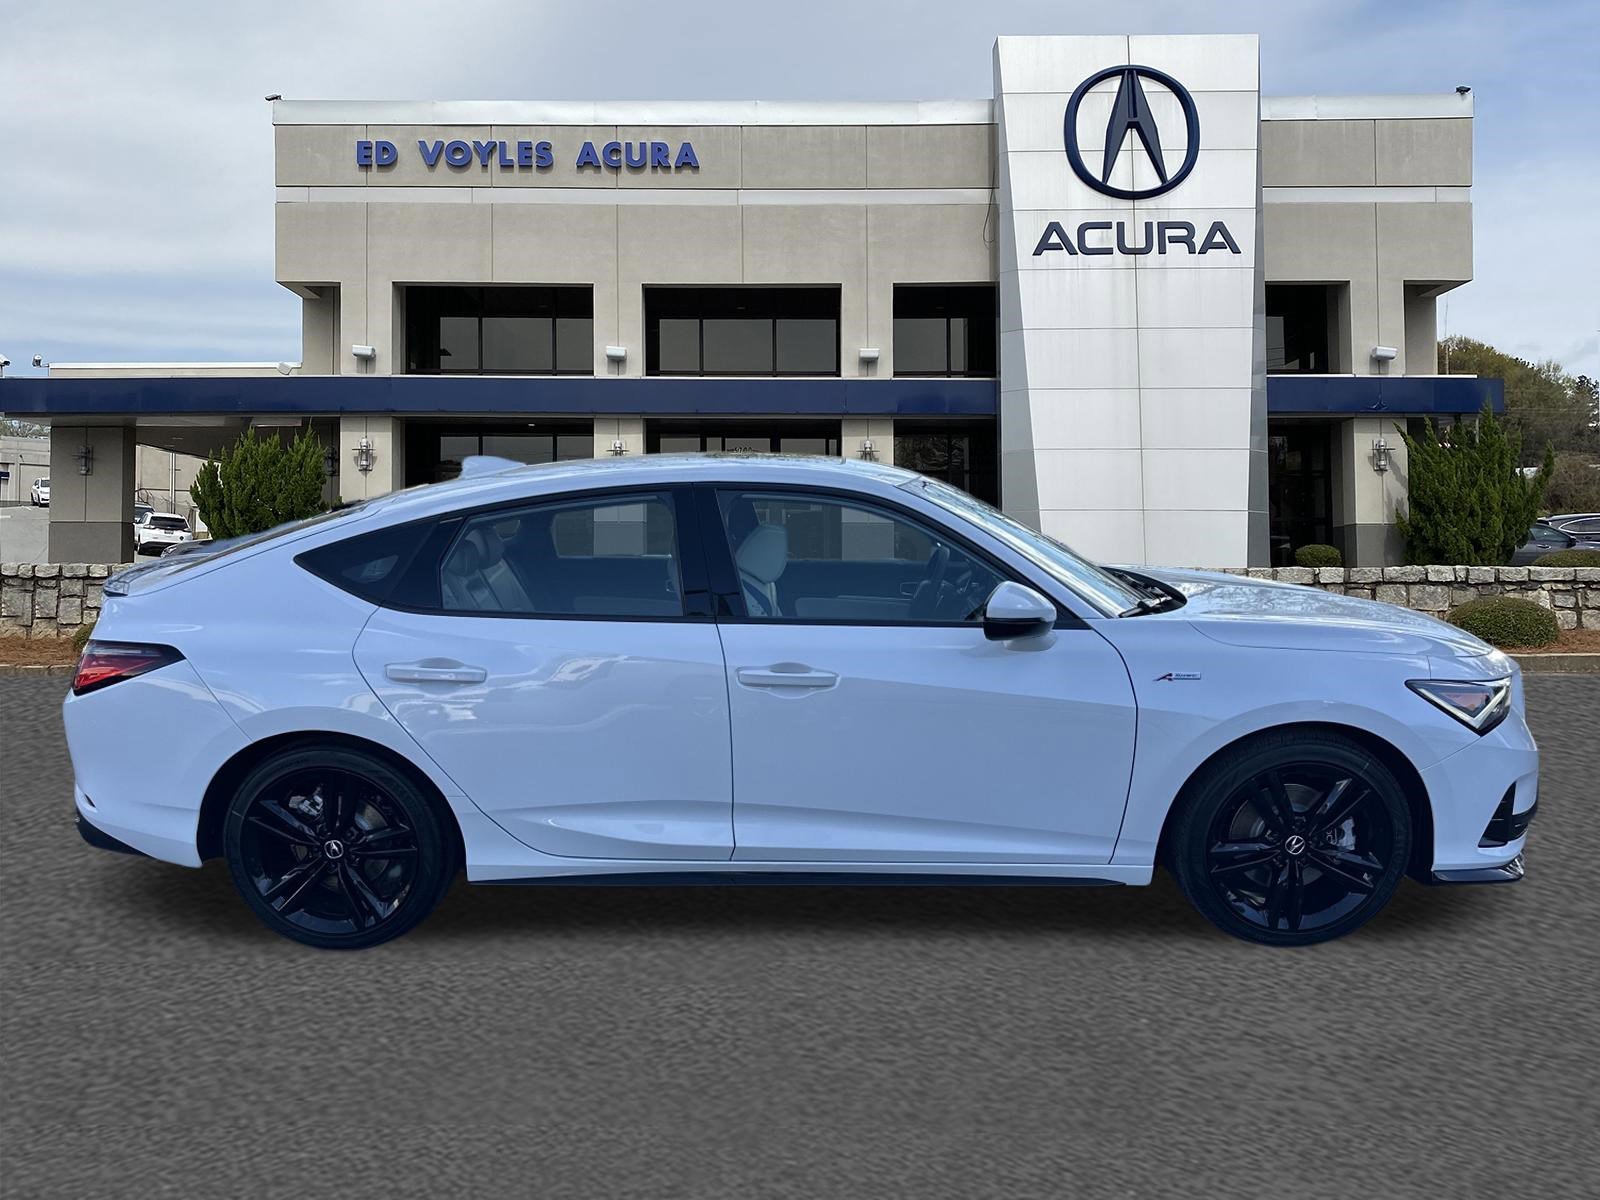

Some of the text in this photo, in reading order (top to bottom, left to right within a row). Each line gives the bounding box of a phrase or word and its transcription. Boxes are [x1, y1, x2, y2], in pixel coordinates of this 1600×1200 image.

[356, 140, 700, 168] ED VOYLES ACURA
[1032, 221, 1242, 256] ACURA
